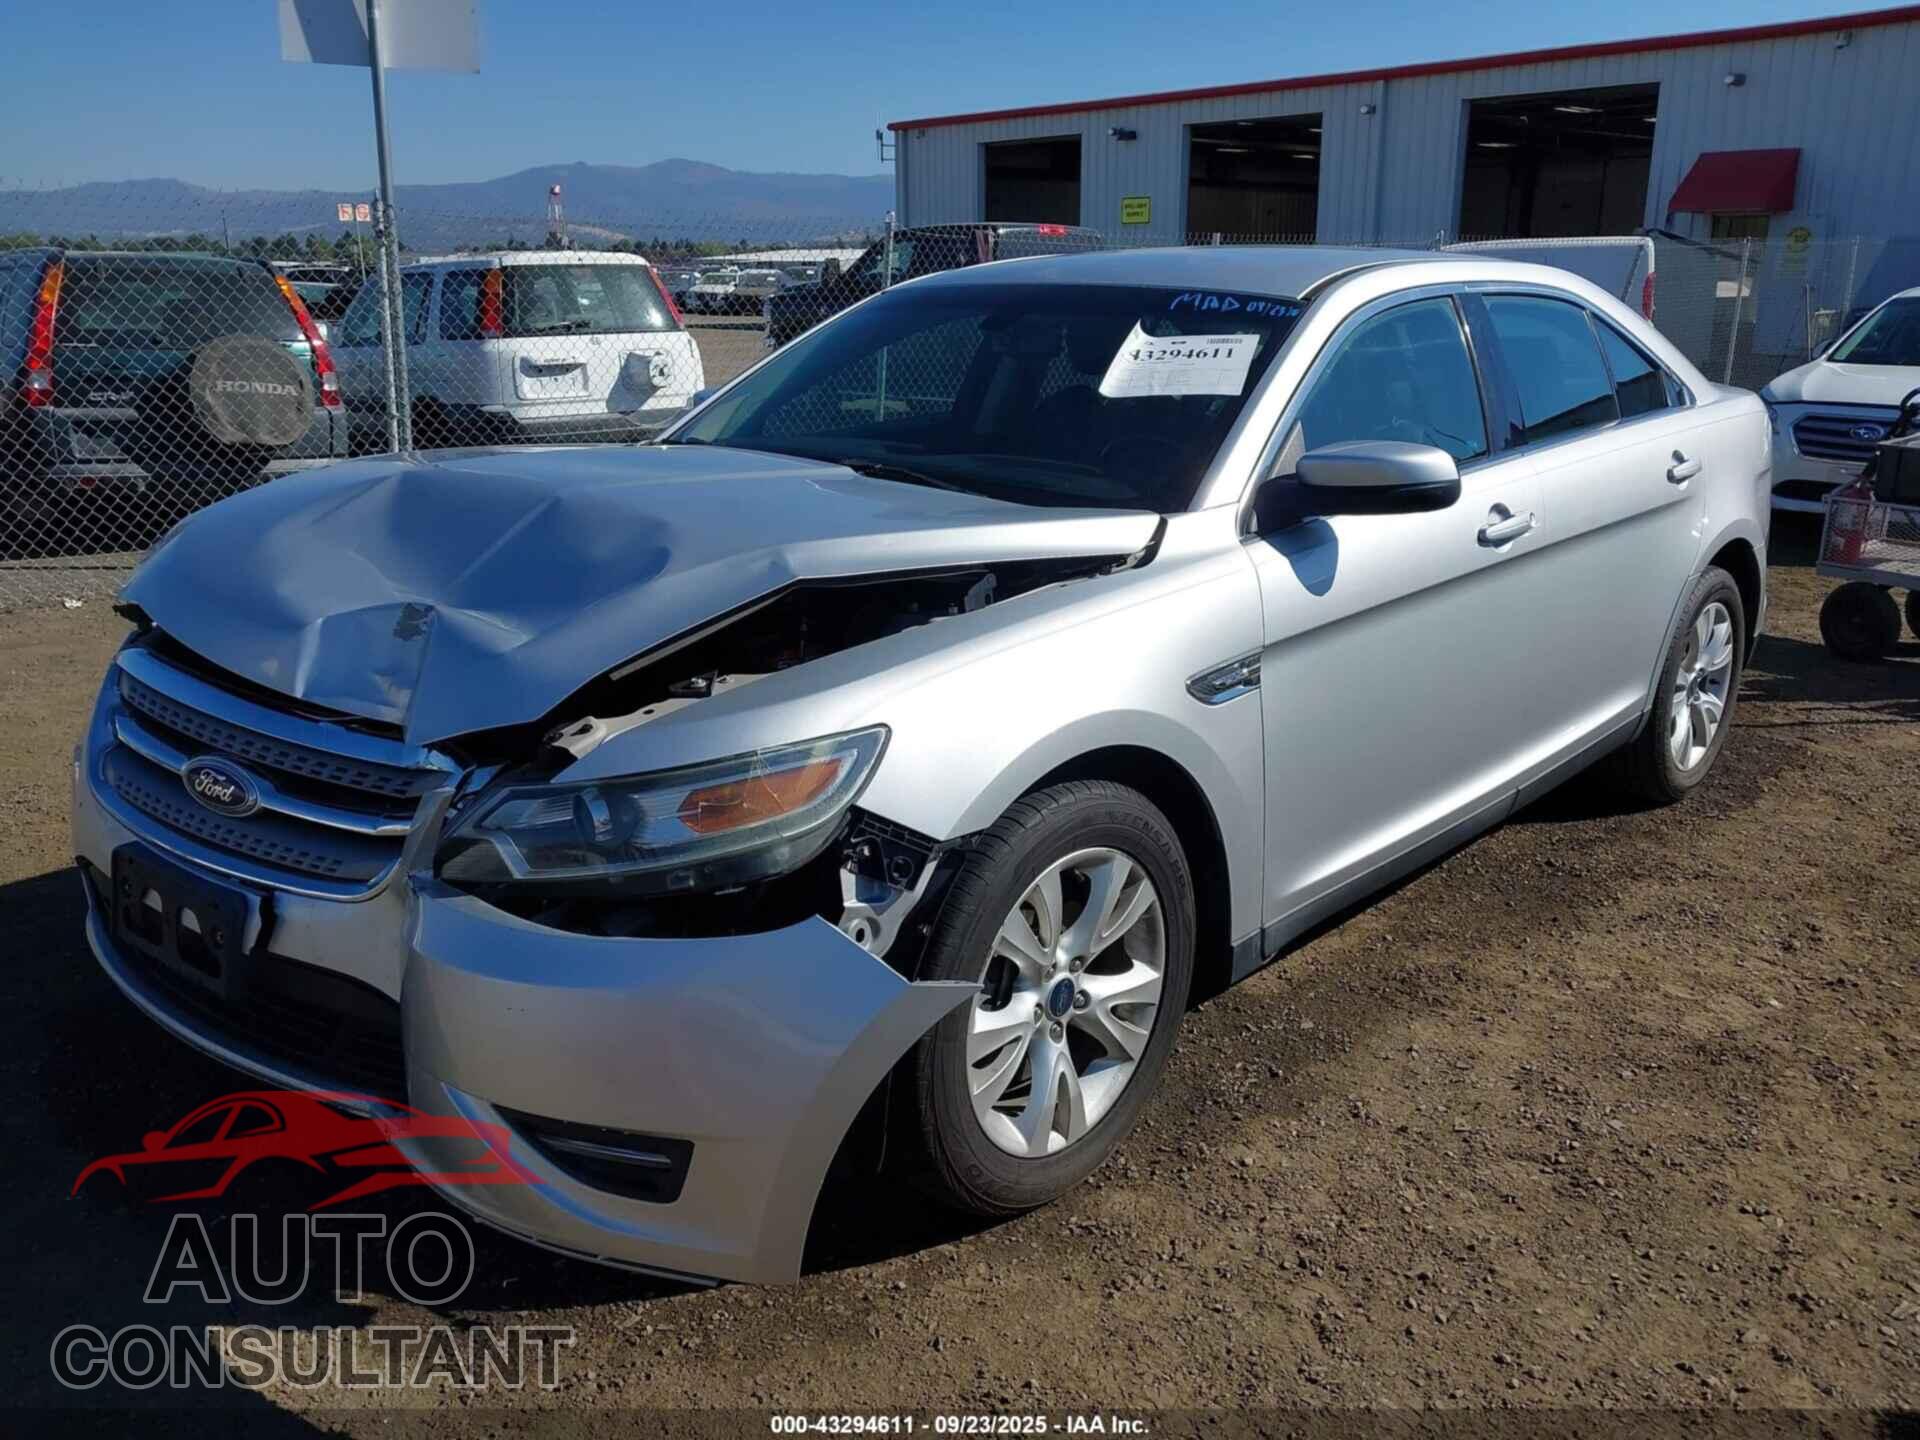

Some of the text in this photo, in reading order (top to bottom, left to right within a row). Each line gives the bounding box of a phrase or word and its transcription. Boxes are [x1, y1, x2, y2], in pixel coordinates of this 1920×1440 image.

[1129, 348, 1235, 362] 43294611
[216, 380, 299, 396] HONDA
[195, 768, 235, 802] Ford
